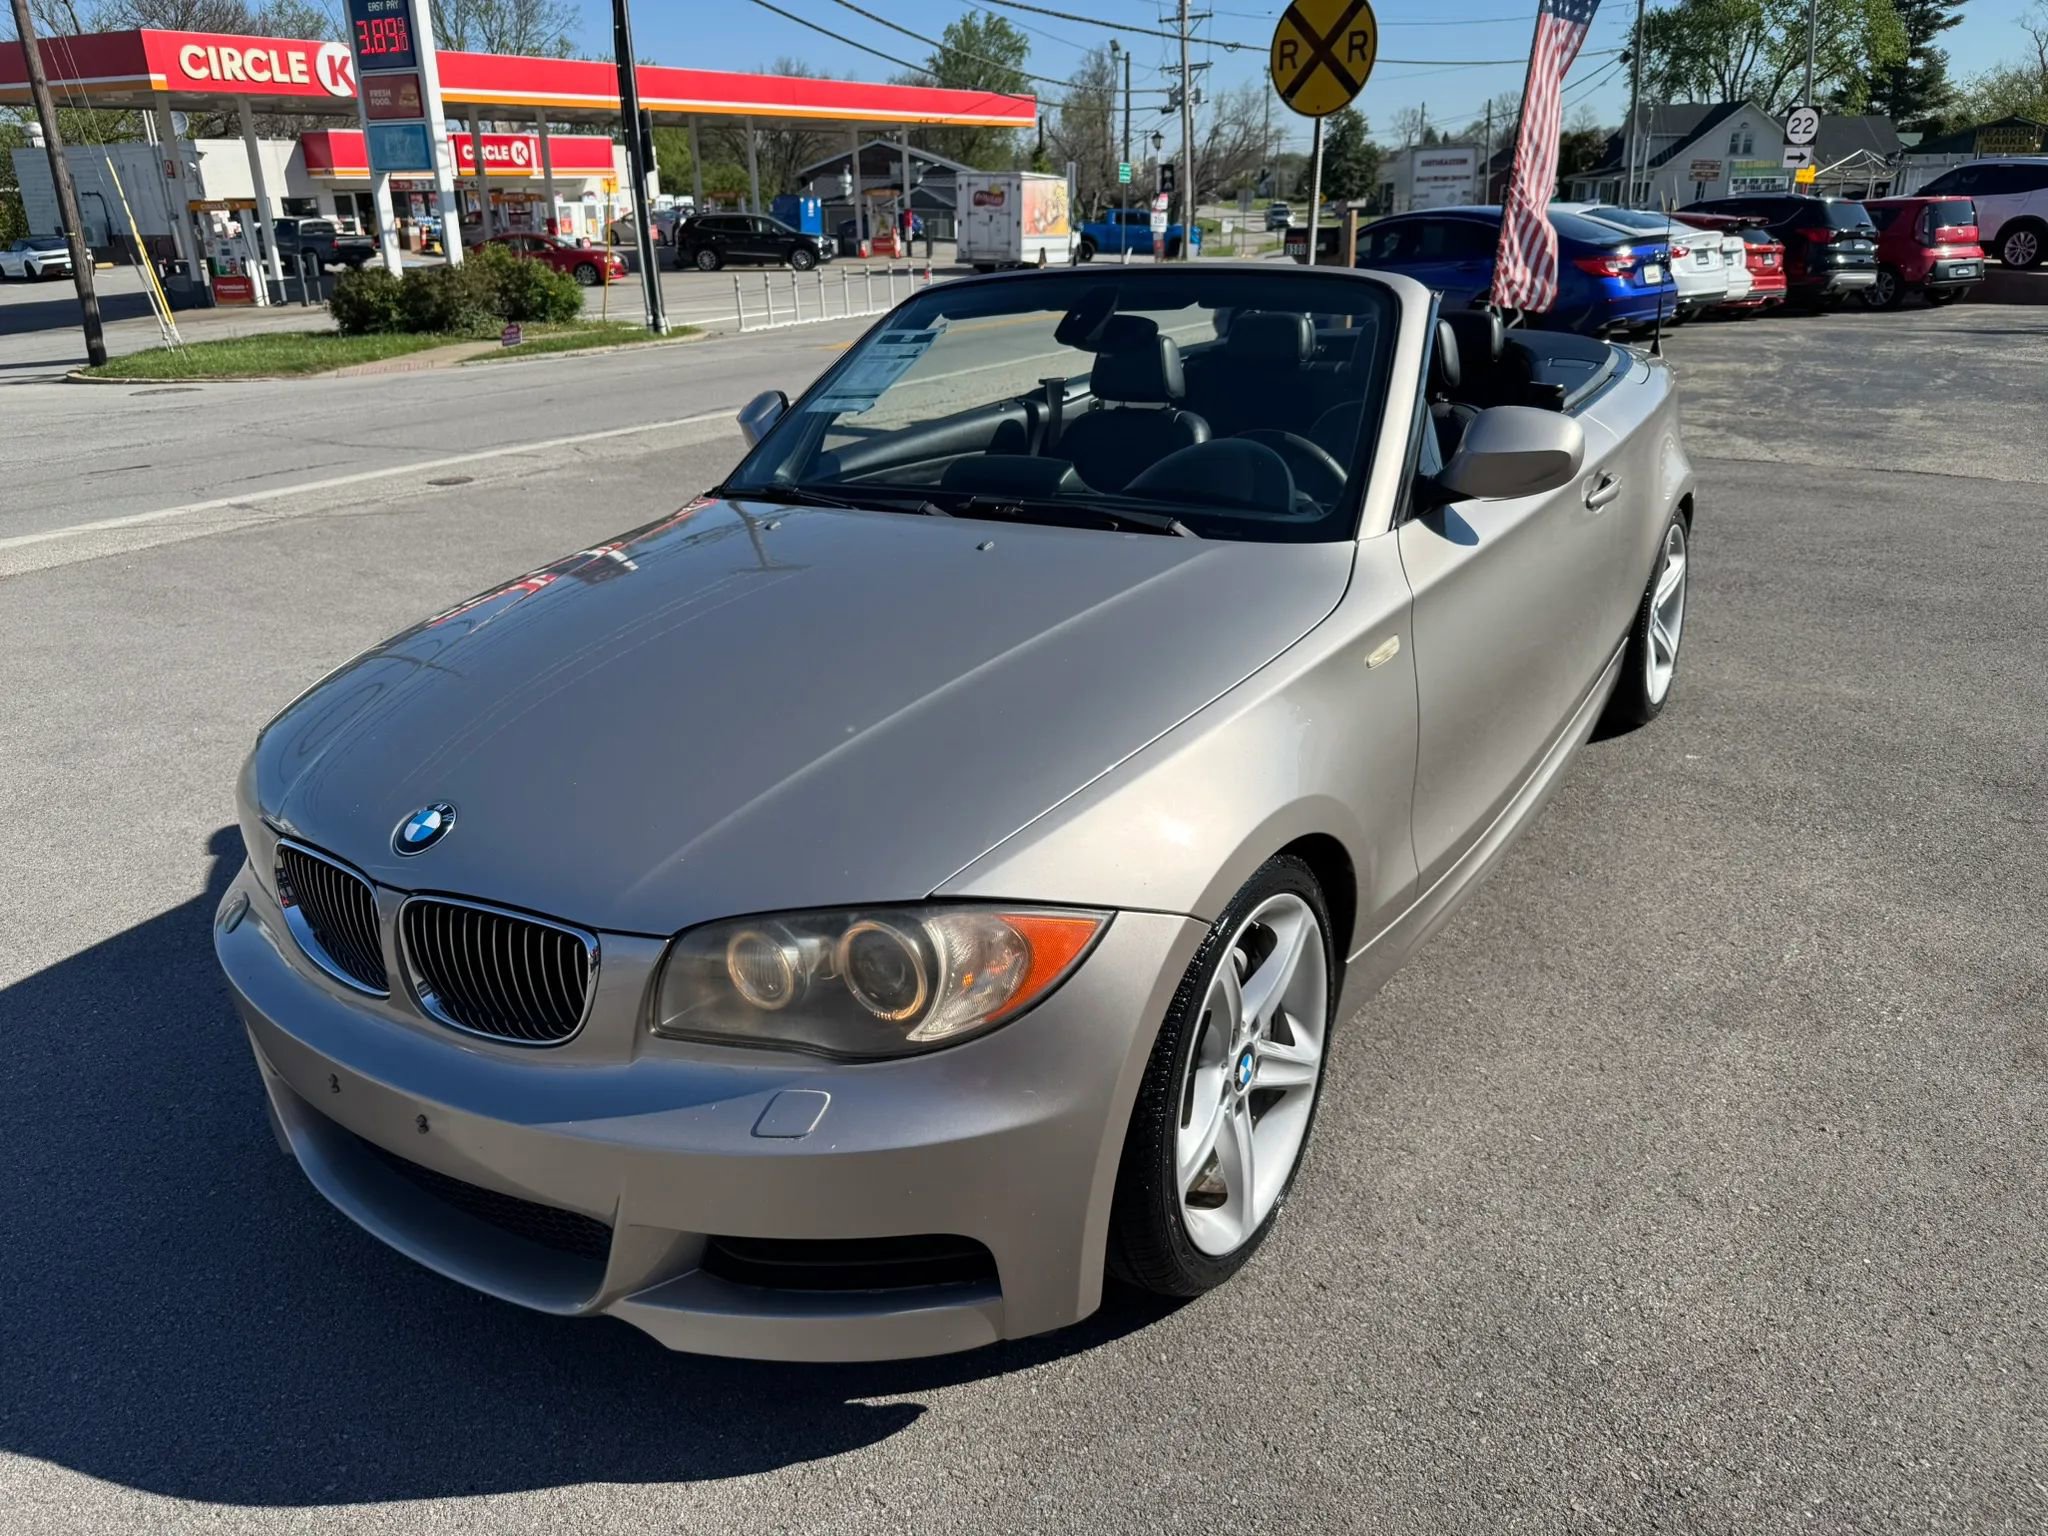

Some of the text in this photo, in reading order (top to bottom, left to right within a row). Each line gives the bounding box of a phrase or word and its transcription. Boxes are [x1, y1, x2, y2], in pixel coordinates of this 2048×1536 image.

[368, 1, 399, 12] EASY PAY
[1279, 39, 1299, 71] R
[1347, 30, 1368, 63] R
[179, 44, 358, 97] CIRCLE K
[369, 89, 392, 97] FRESH
[1790, 117, 1814, 134] 22
[462, 144, 510, 161] CRCLE
